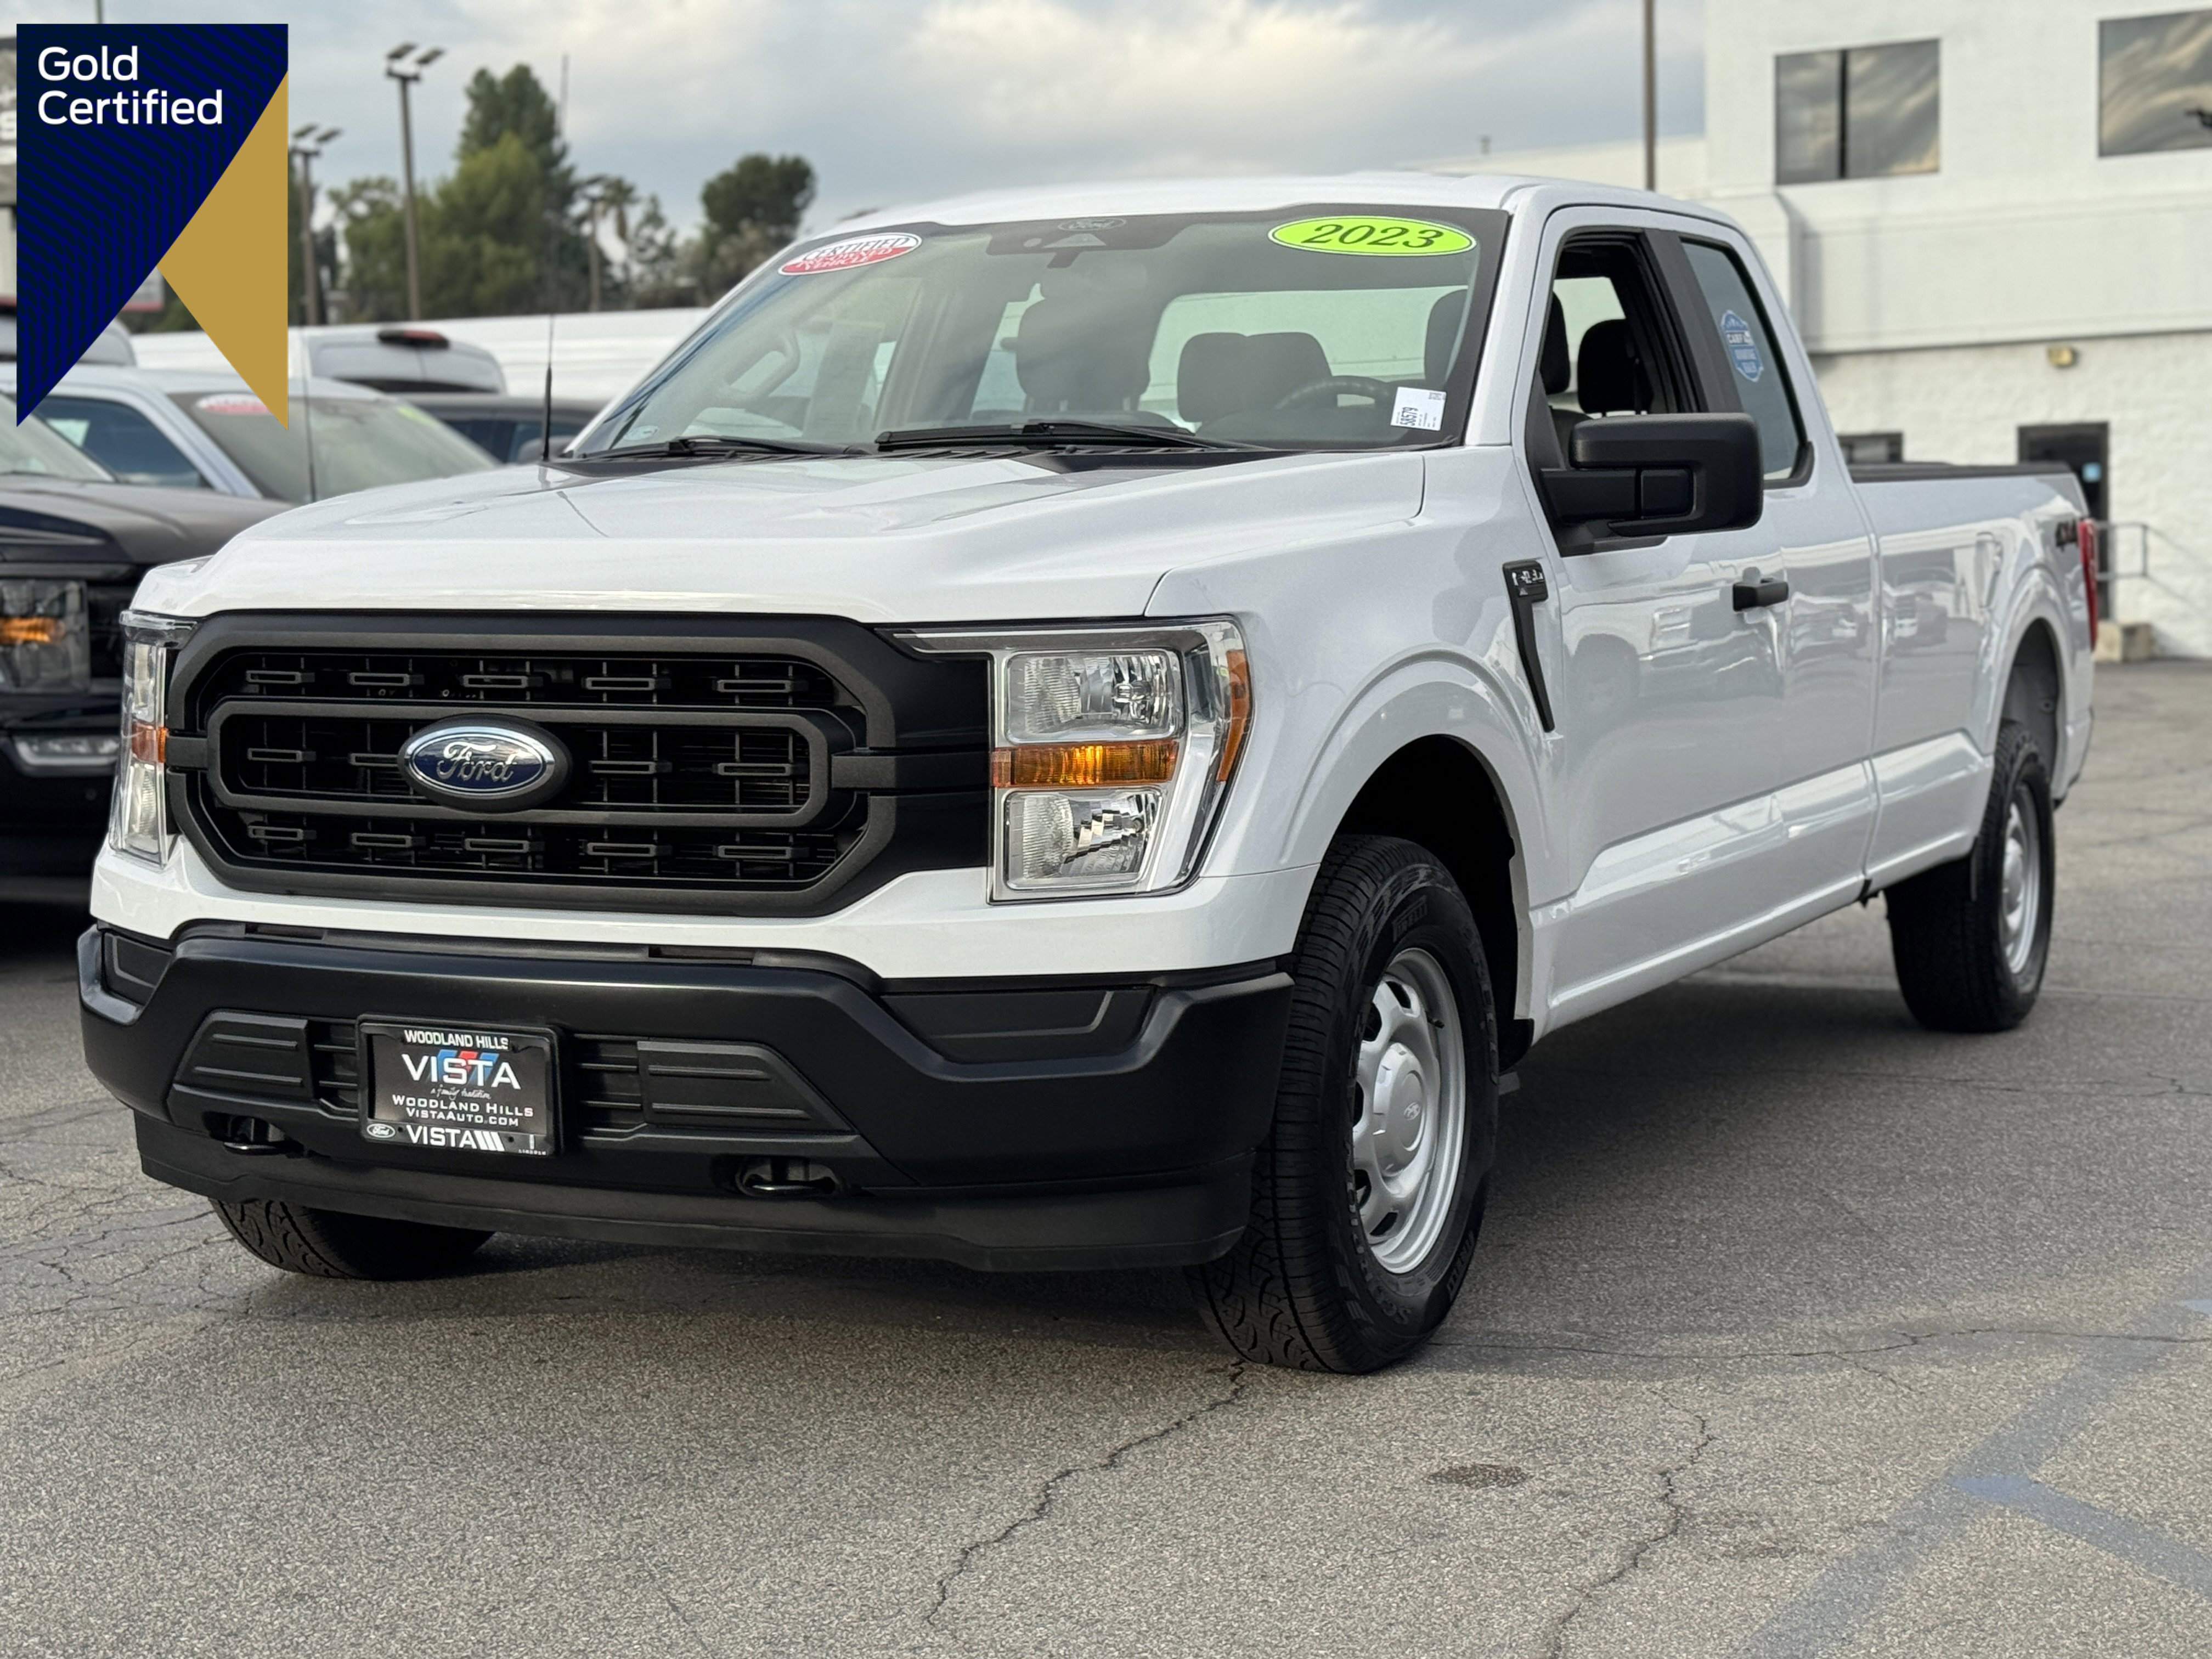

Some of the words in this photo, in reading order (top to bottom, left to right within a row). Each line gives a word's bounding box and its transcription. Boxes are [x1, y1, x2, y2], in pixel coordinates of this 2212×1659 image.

[1301, 224, 1444, 248] 2023
[436, 741, 517, 782] Ford
[404, 1029, 473, 1048] WOODLAND
[476, 1036, 509, 1050] HILLS
[401, 1053, 522, 1090] VISTA
[392, 1094, 480, 1113] WOODLAND
[486, 1102, 534, 1118] HILLS
[406, 1125, 477, 1149] VISTA
